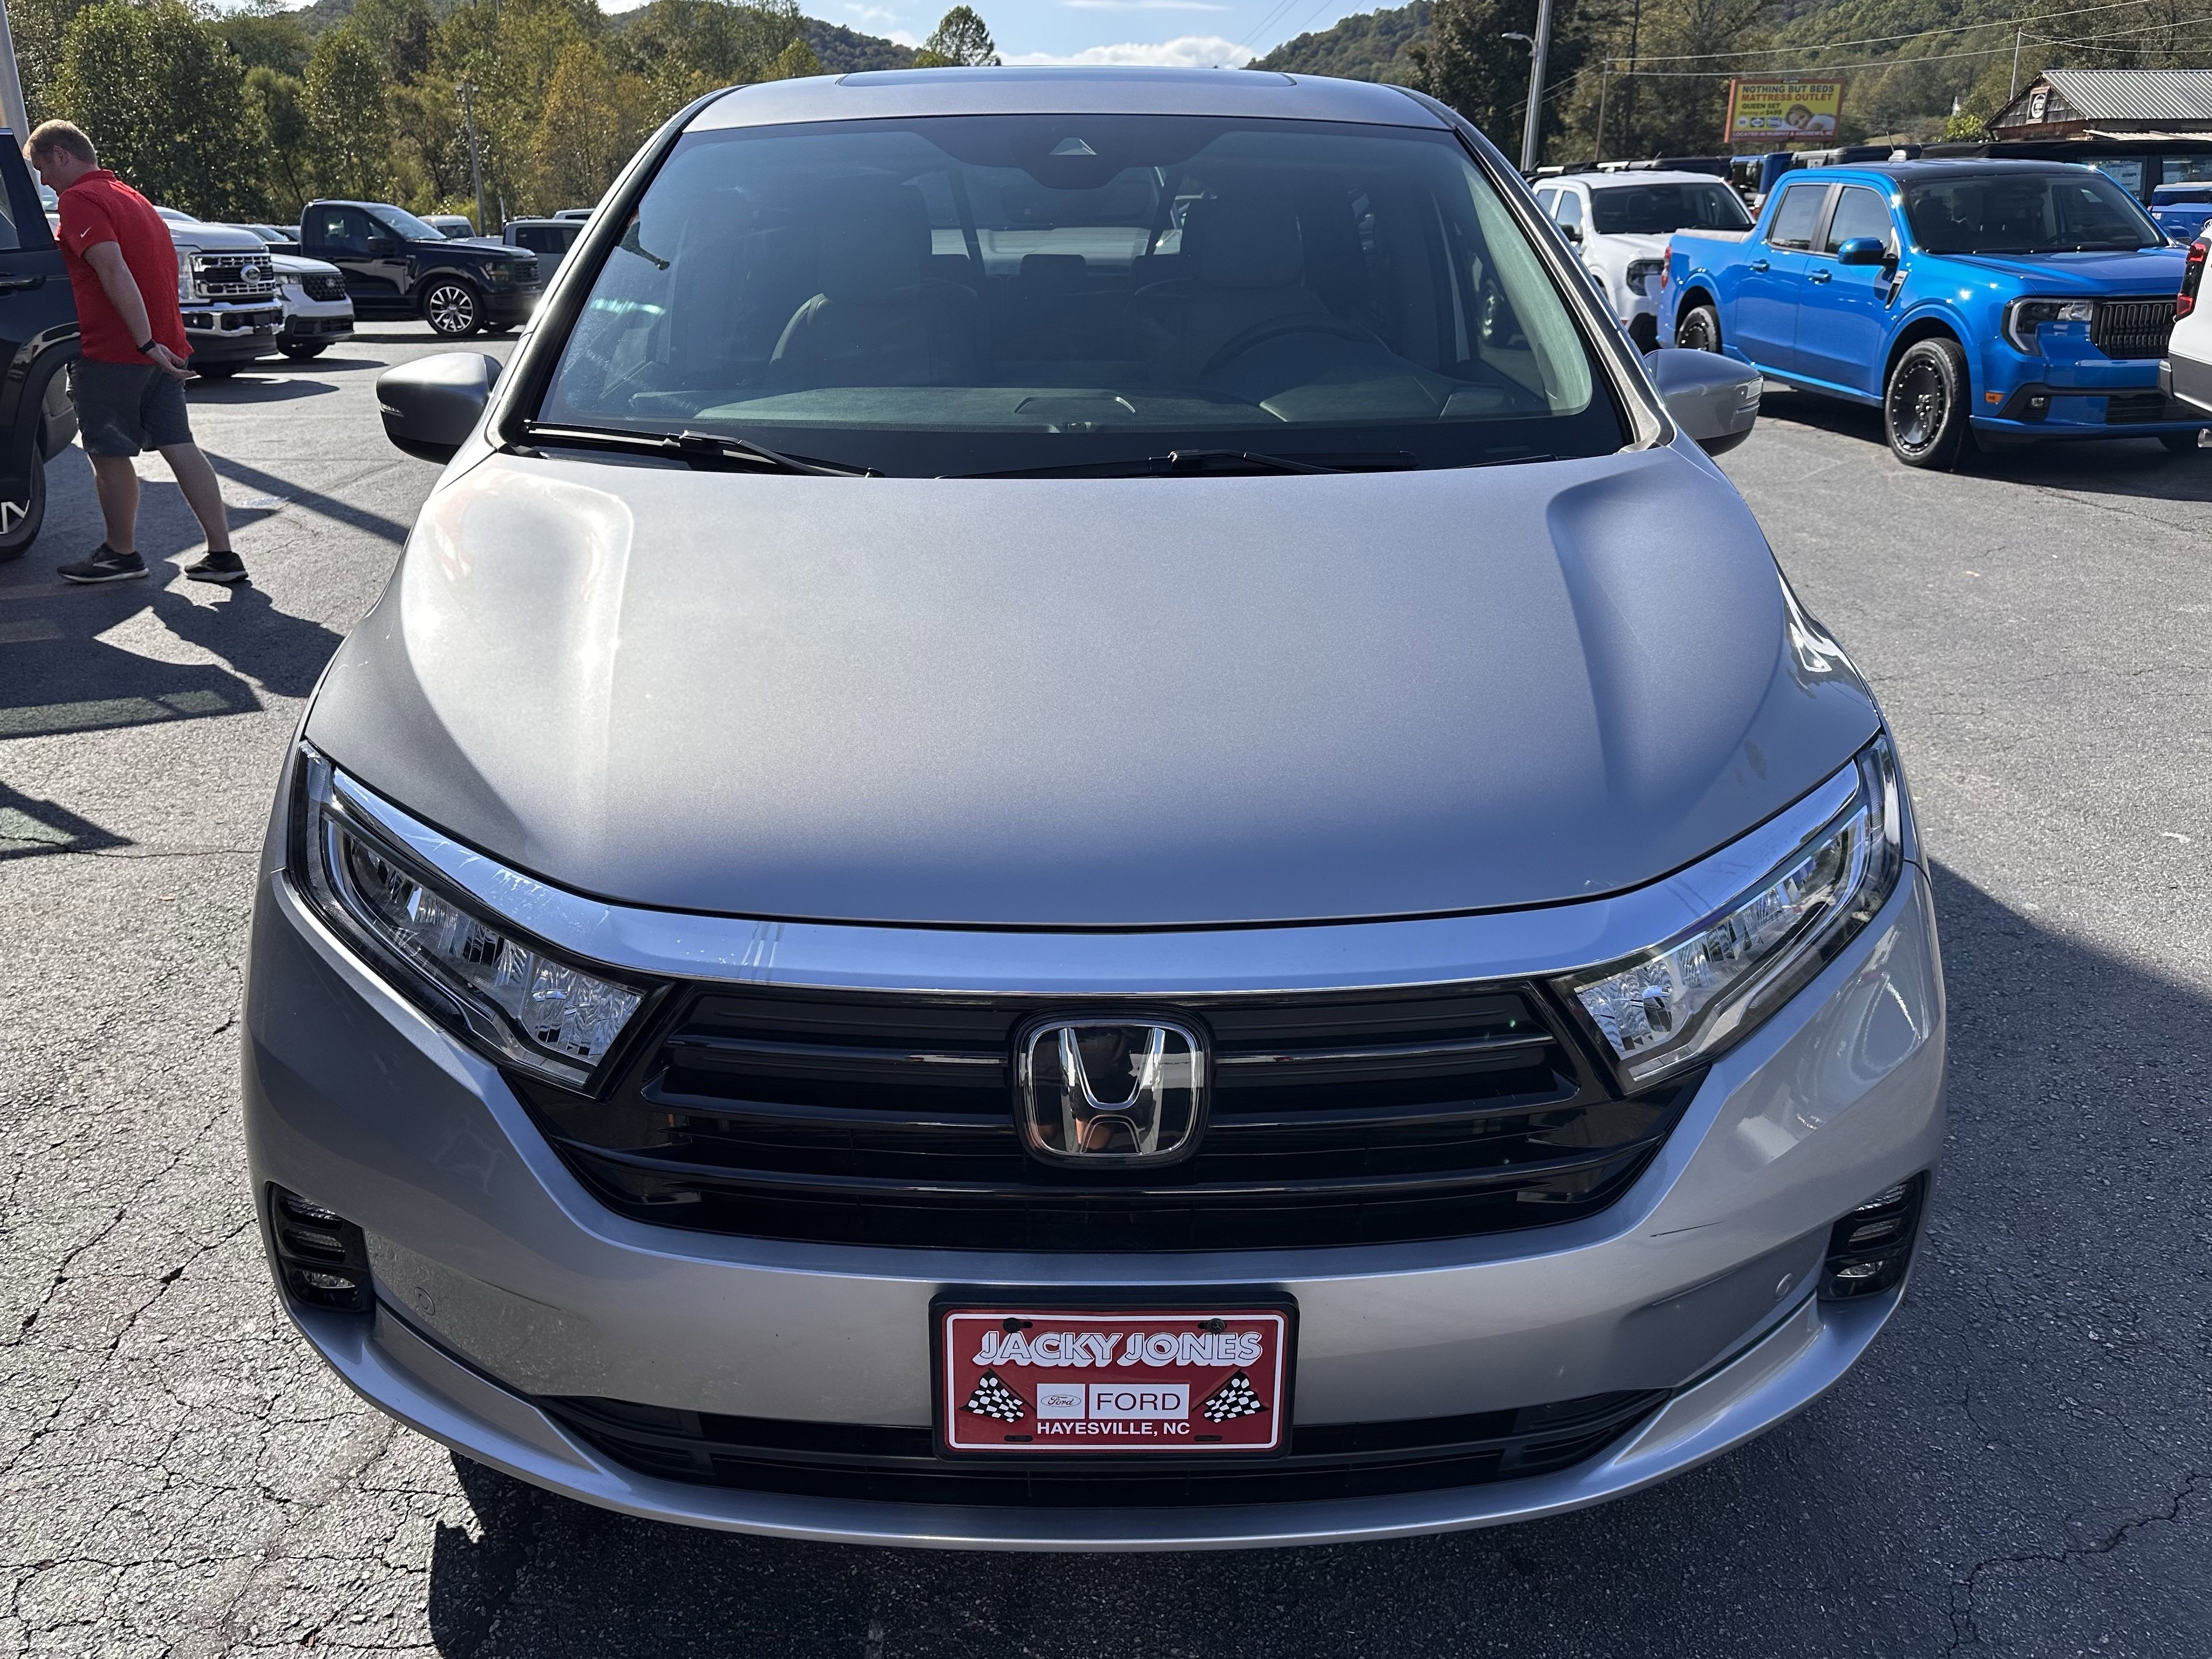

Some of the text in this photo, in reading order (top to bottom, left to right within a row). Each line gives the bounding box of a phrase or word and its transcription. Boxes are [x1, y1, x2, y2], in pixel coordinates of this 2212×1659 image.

[972, 1331, 1263, 1367] JACKY JONES
[1047, 1396, 1074, 1406] Ford
[1097, 1393, 1181, 1411] FORD
[1037, 1422, 1190, 1436] HAYESVILLE, NC
